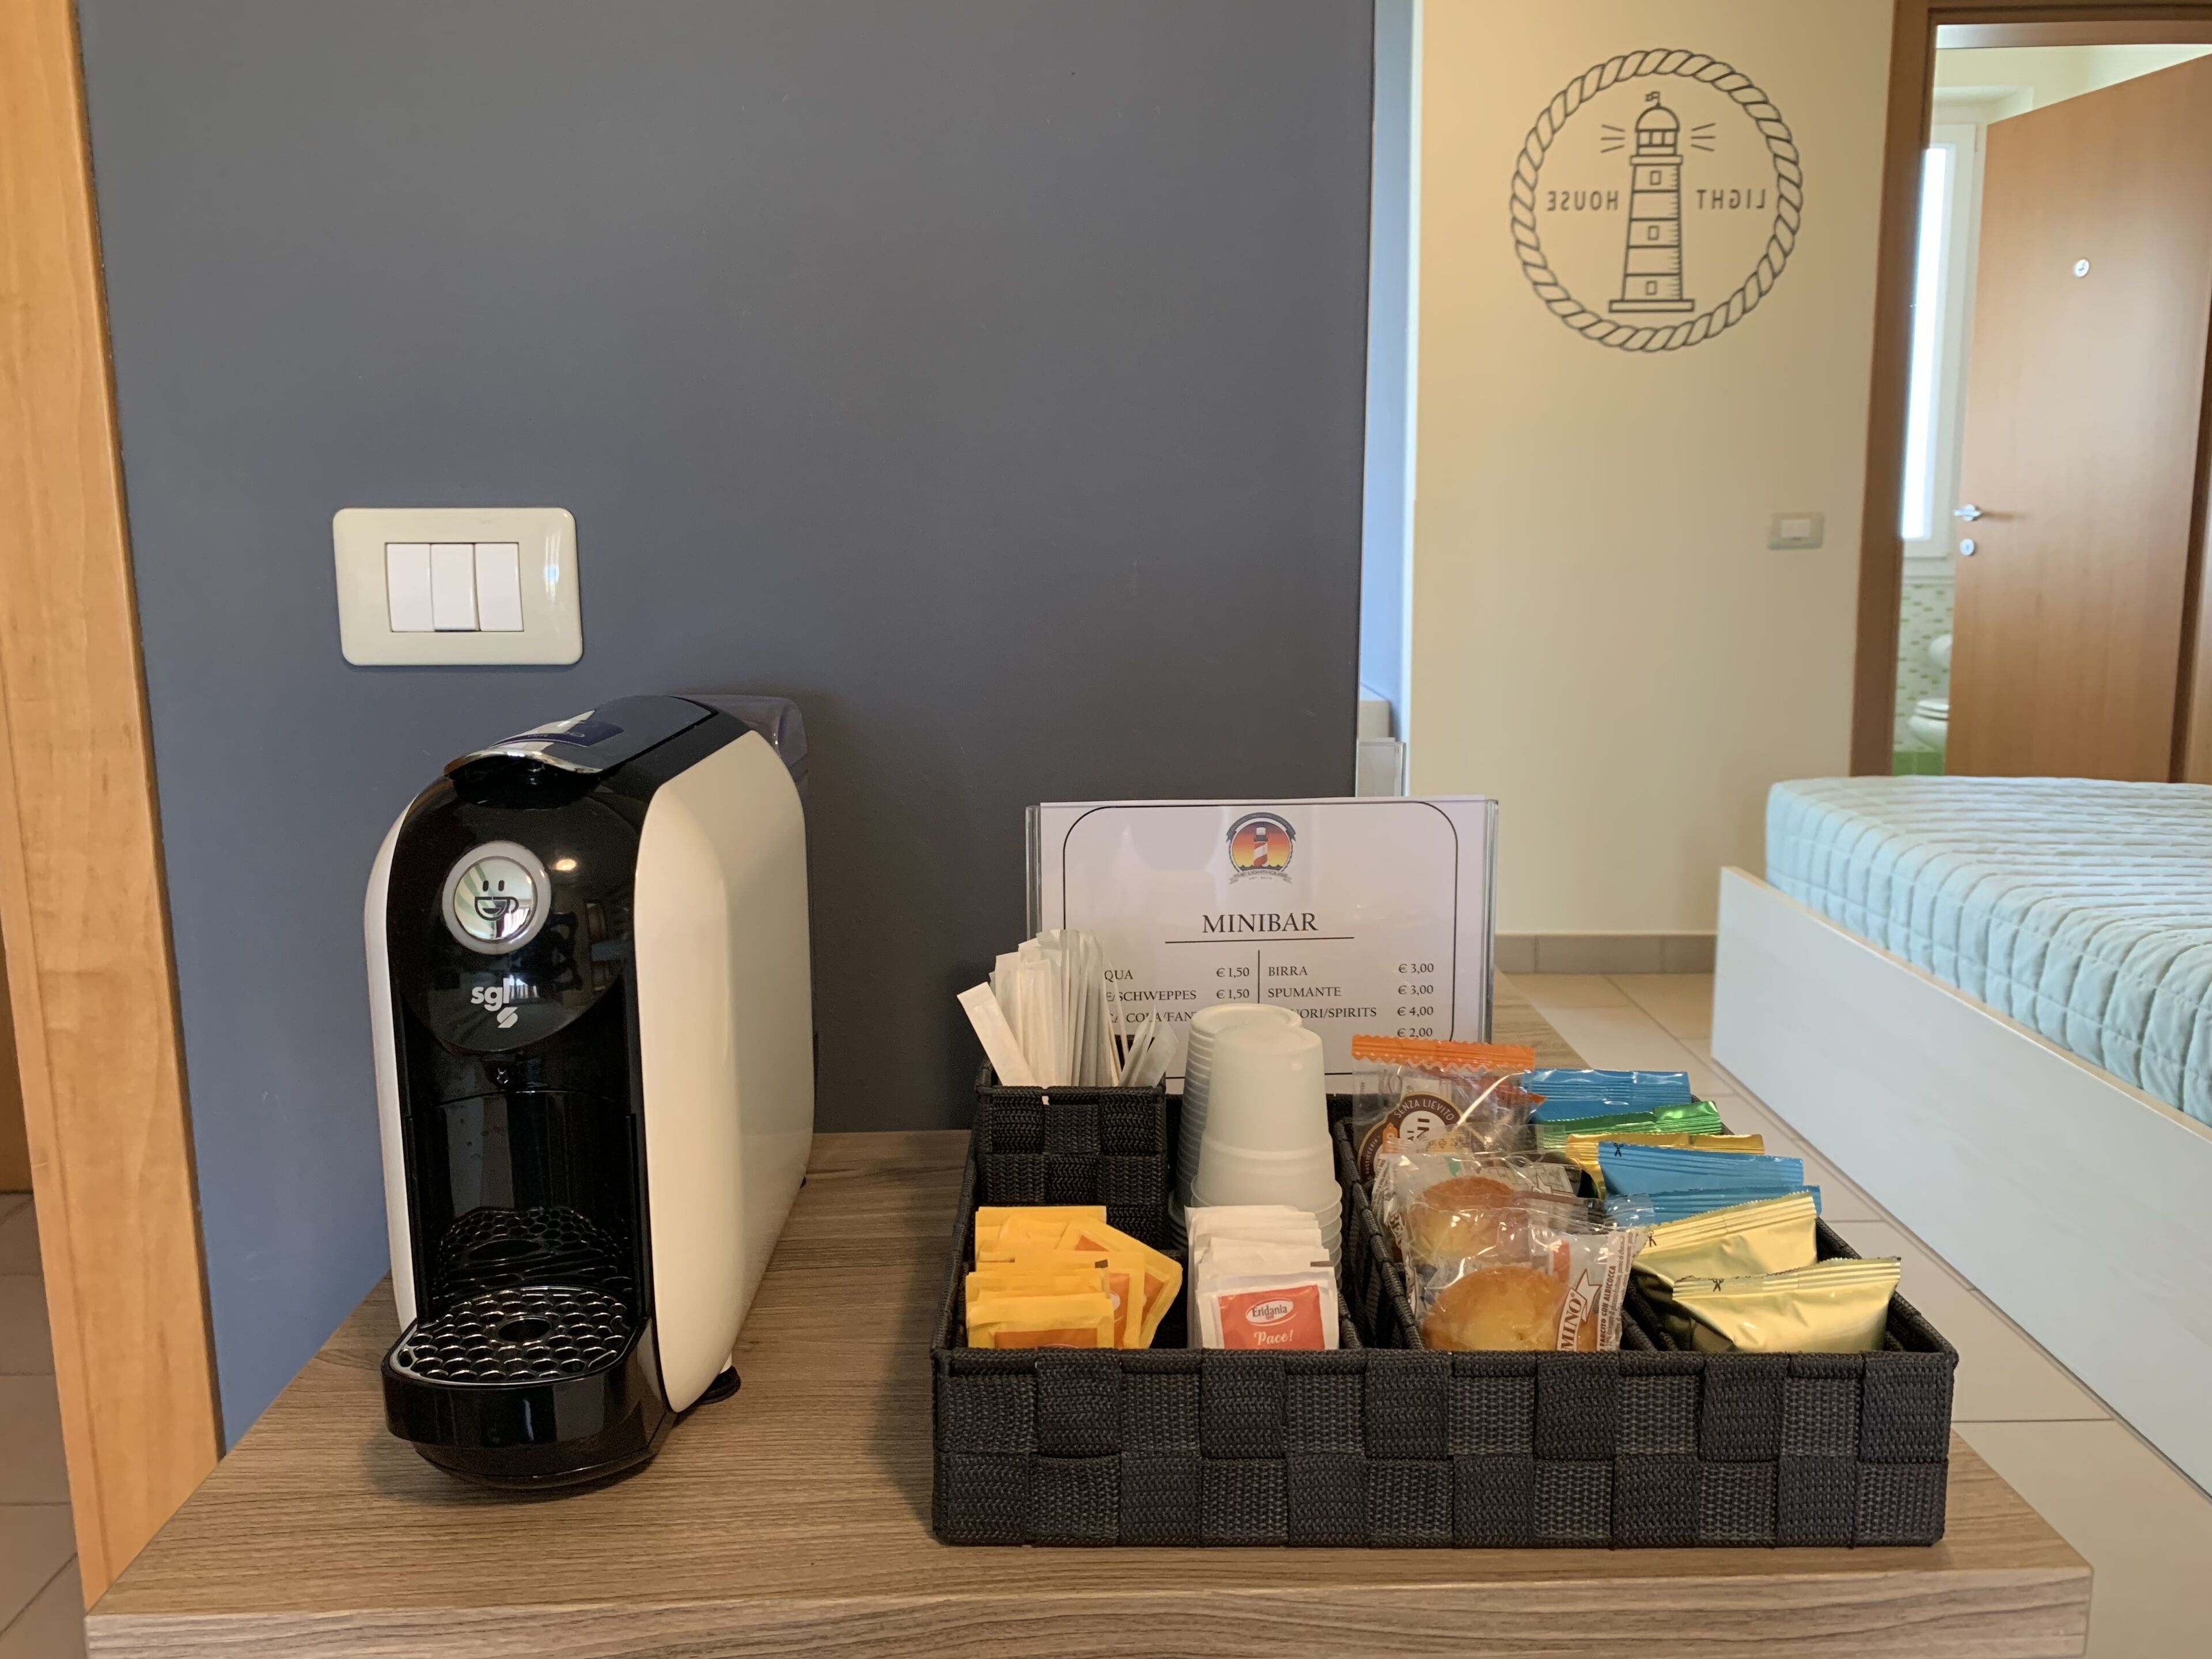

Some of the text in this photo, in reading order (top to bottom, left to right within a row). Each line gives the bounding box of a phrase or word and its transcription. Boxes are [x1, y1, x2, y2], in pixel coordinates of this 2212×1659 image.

[1202, 912, 1319, 933] MINIBAR
[1104, 969, 1133, 982] QUA
[1268, 966, 1308, 976] BIRRA
[471, 978, 510, 1012] sgl
[1268, 987, 1342, 998] SPUMANTE
[1394, 1098, 1455, 1121] SENZA LIEVITO
[1604, 1266, 1616, 1301] ALBICOCCA
[1252, 1304, 1287, 1317] Eridania
[1253, 1329, 1294, 1346] Pace!
